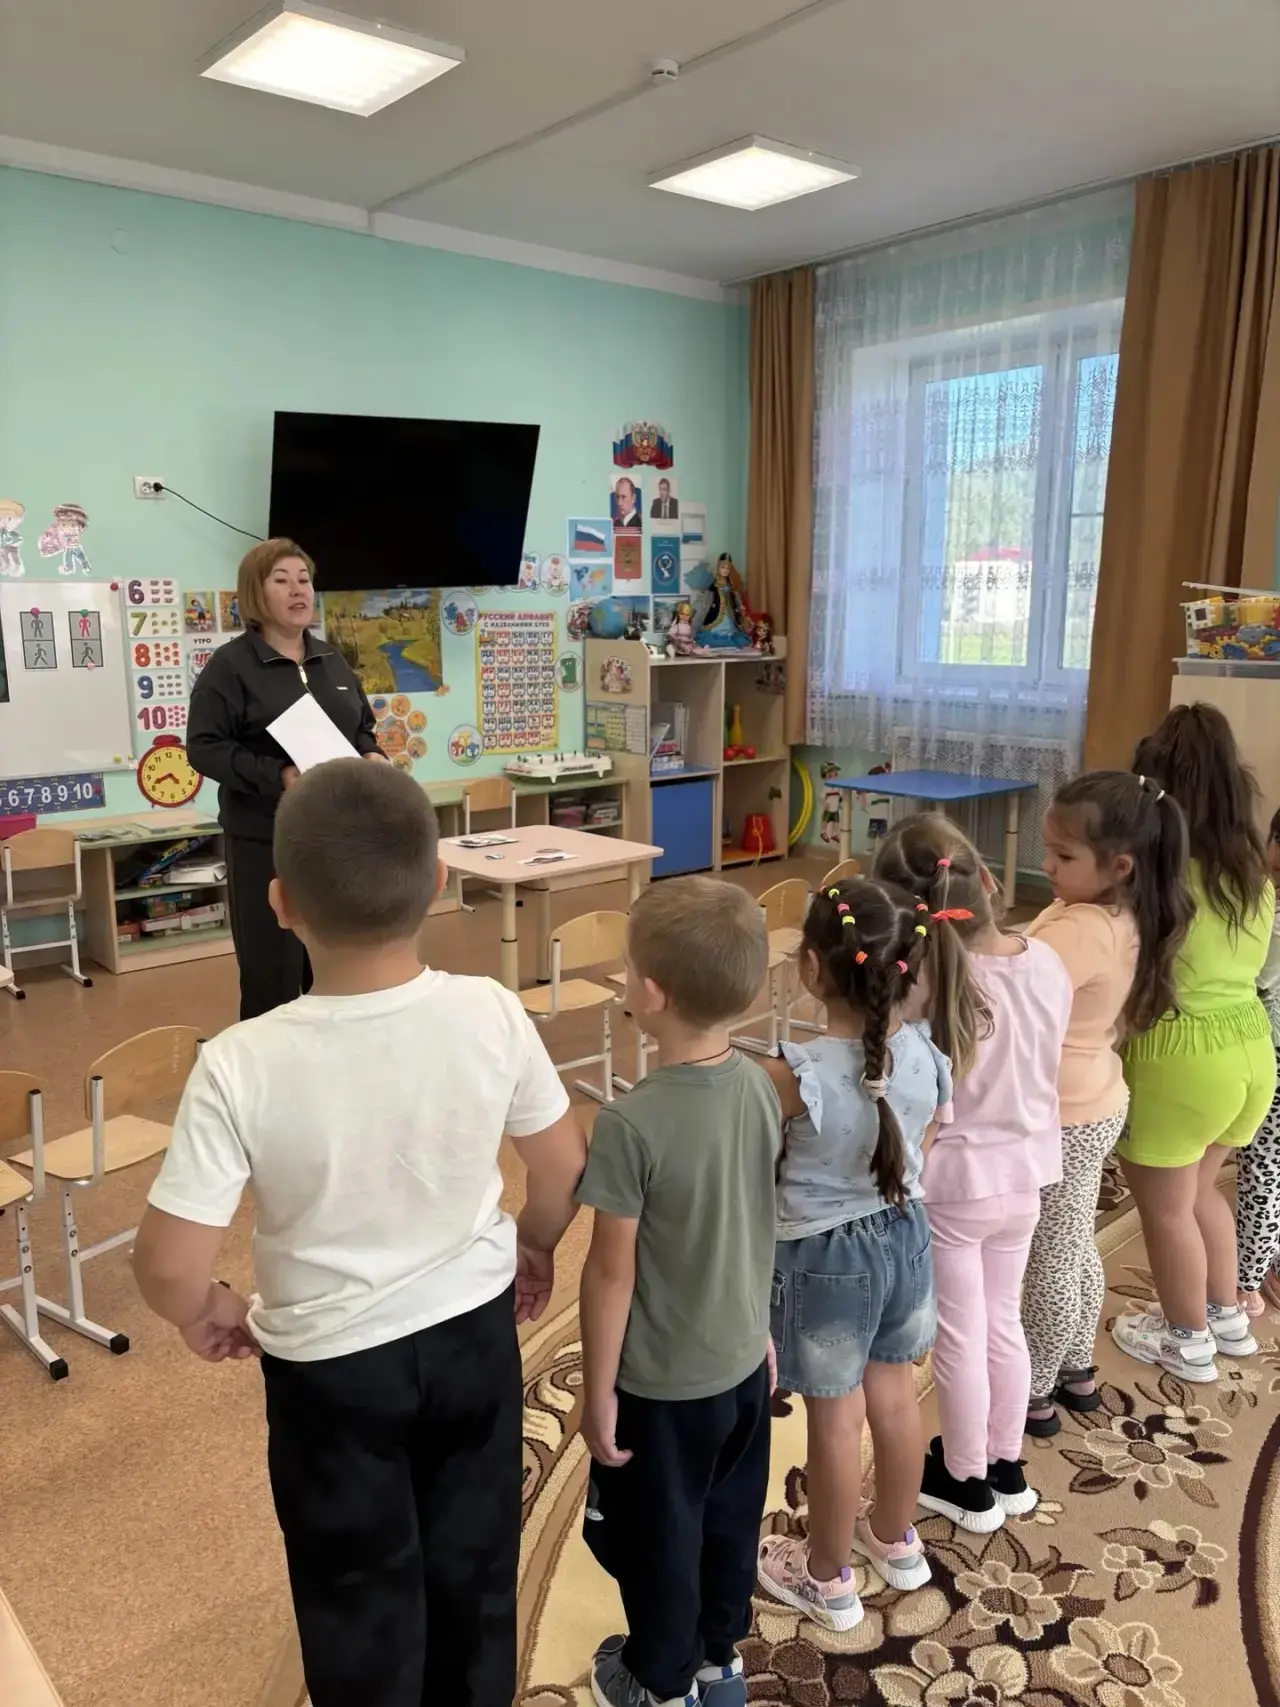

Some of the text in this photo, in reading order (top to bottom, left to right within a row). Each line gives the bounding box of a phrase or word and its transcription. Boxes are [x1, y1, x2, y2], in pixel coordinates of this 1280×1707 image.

[128, 580, 145, 605] 6
[130, 612, 147, 636] 7
[135, 643, 151, 667] 8
[137, 675, 154, 699] 9
[137, 706, 167, 730] 10
[8, 789, 20, 807] 6
[23, 788, 35, 805] 7
[41, 786, 52, 803] 8
[57, 784, 68, 802] 9
[73, 782, 93, 800] 10
